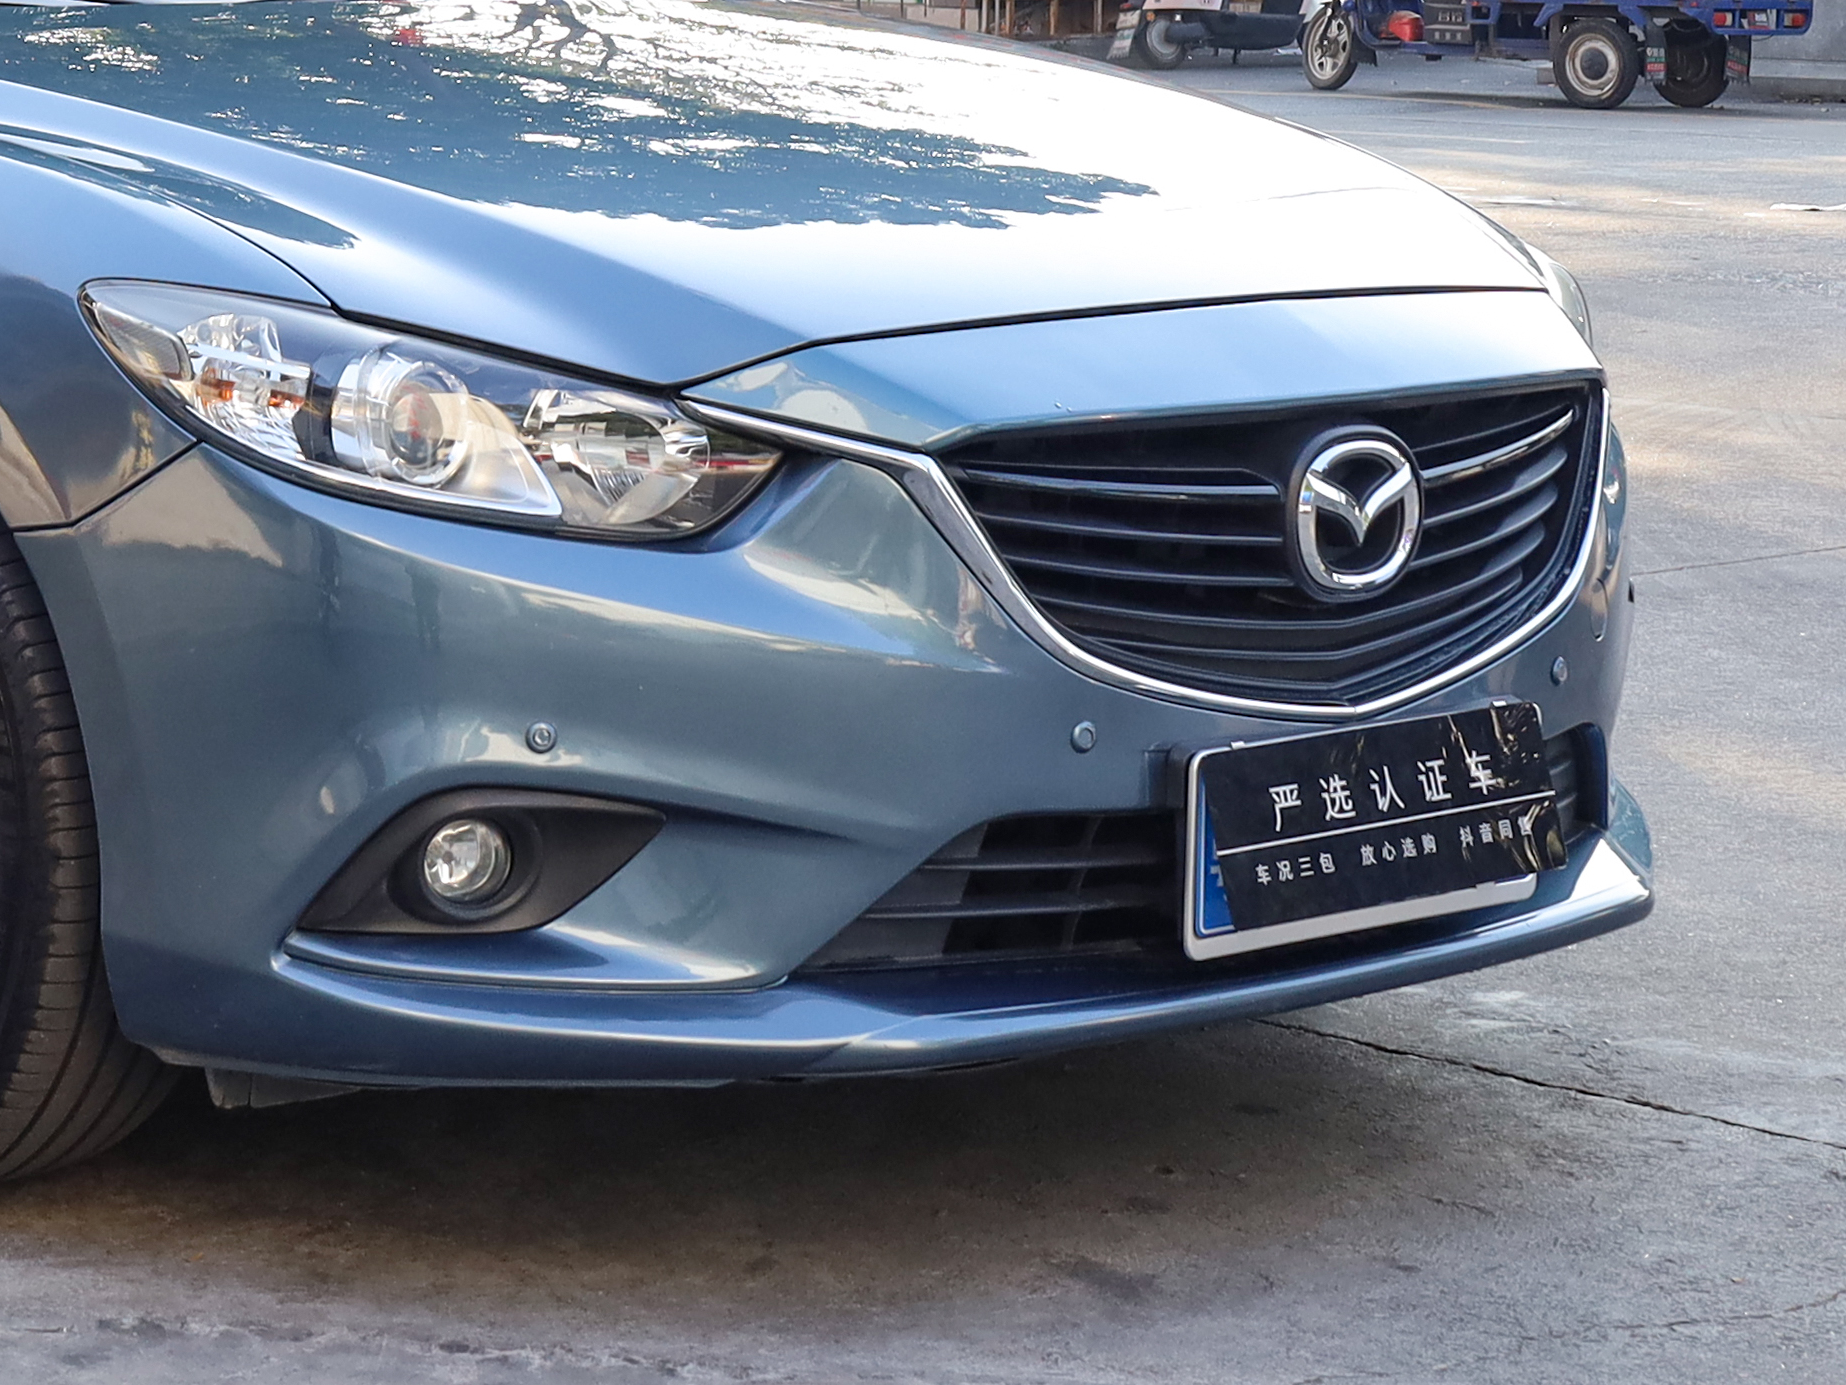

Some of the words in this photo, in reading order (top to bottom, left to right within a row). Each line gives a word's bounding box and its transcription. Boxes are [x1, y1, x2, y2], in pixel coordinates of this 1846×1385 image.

[1268, 749, 1501, 833] 严选认证车
[1255, 852, 1336, 886] 车况三包
[1359, 832, 1437, 866] 放心选购
